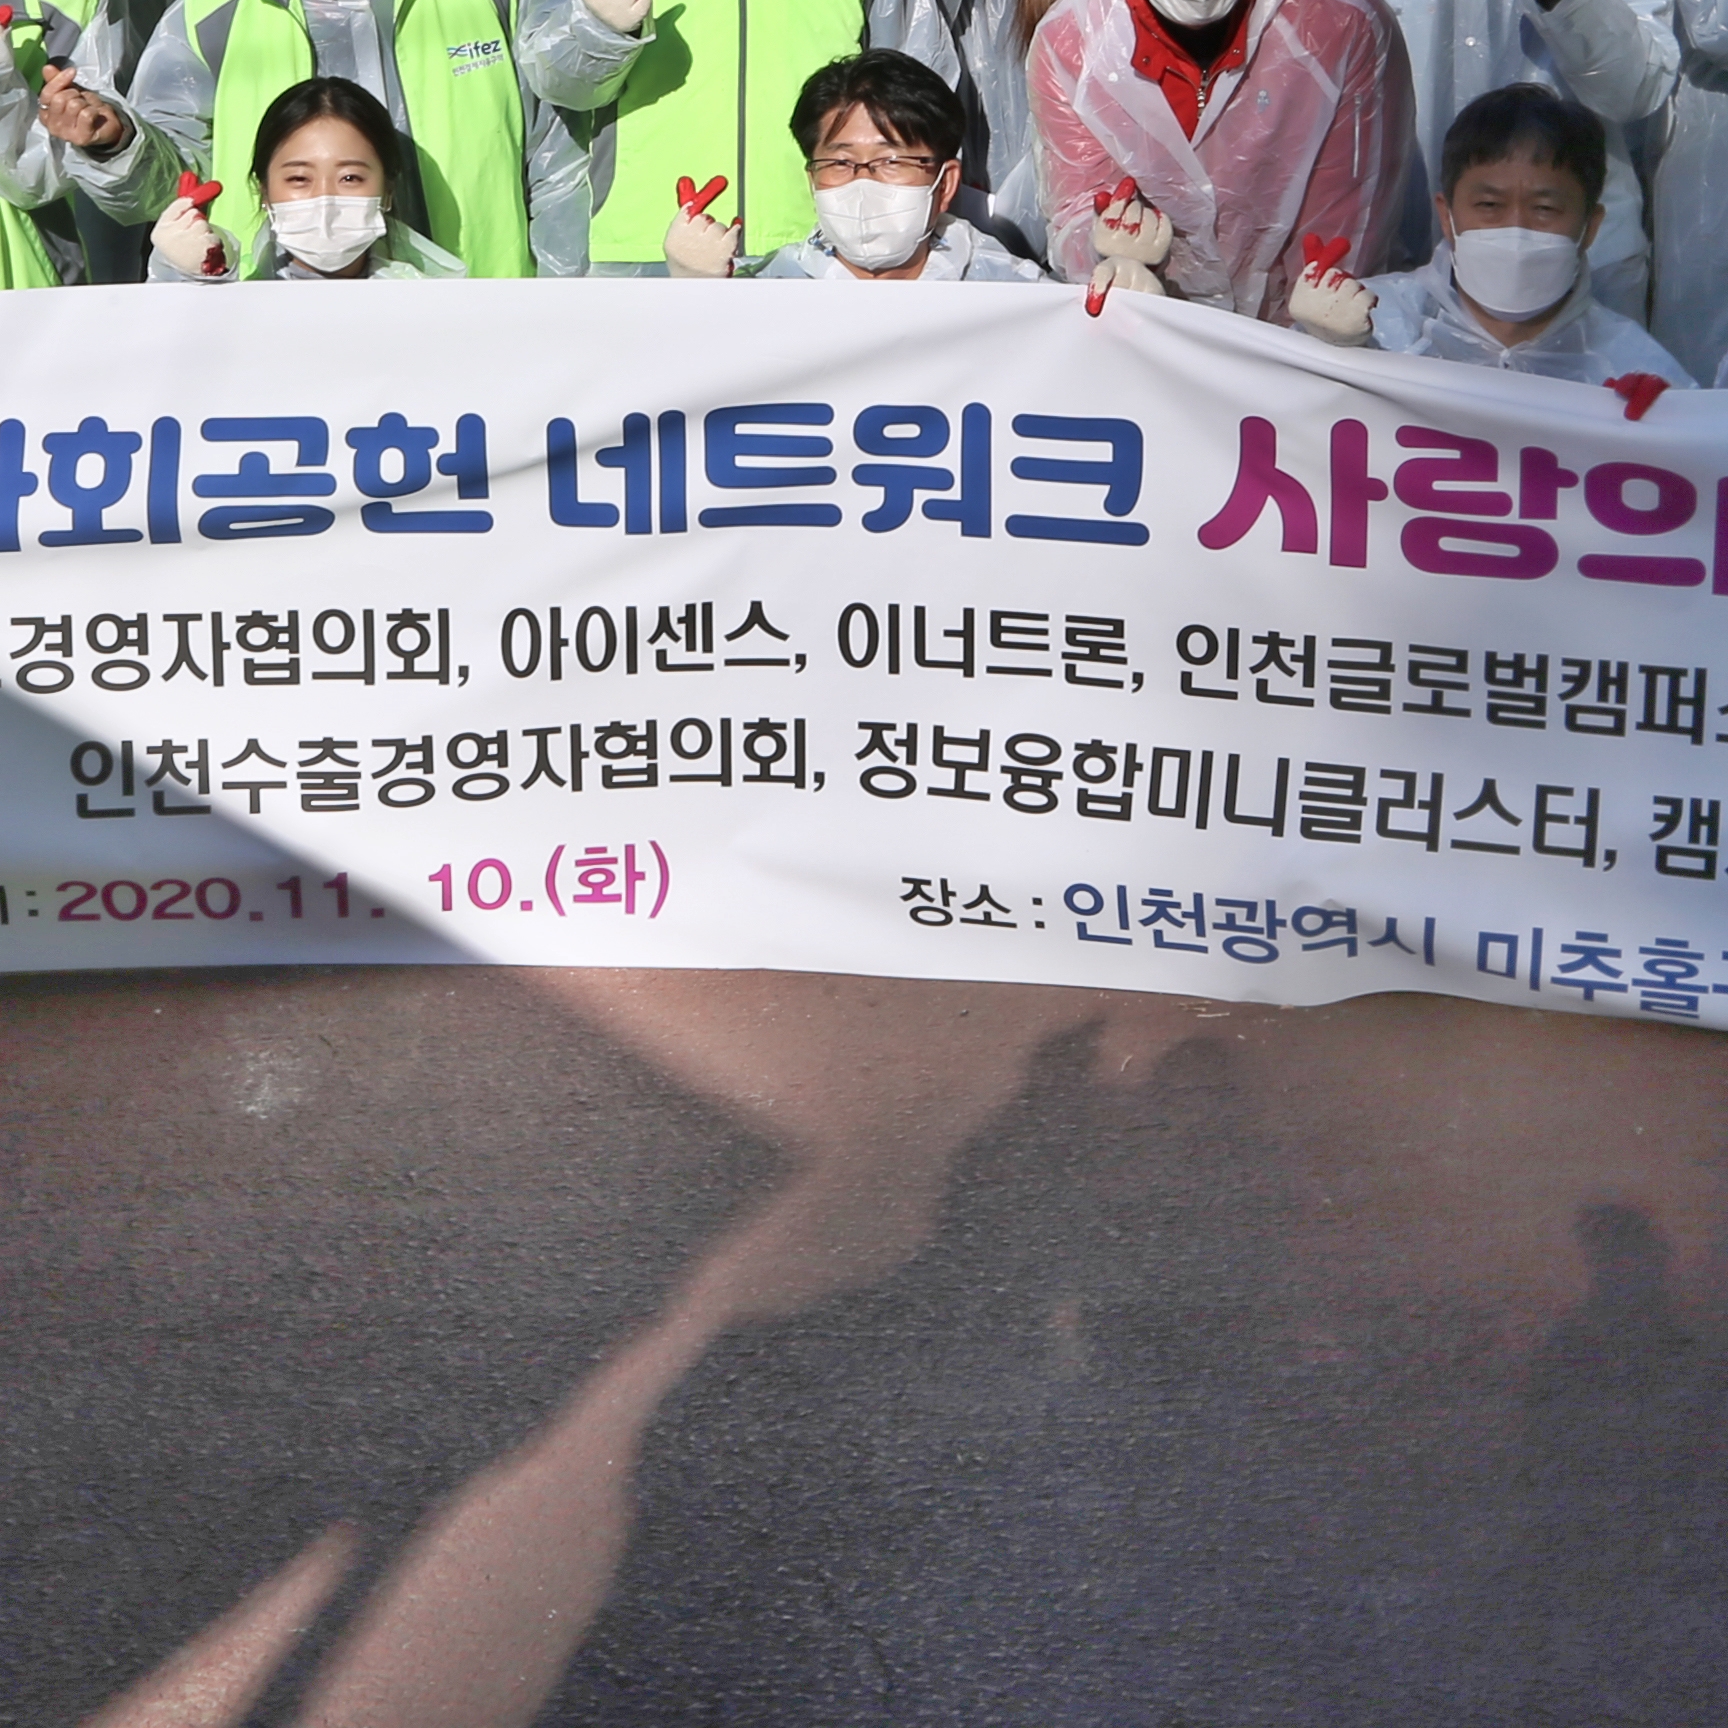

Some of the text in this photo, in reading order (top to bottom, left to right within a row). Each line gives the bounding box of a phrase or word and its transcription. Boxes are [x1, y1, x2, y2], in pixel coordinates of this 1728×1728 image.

[467, 40, 502, 59] ifez
[546, 402, 1150, 547] 네트워크
[500, 599, 808, 682] 아이센스,
[836, 601, 1145, 694] 이너트론,
[70, 716, 826, 820] 인천수출경영자협의회,
[854, 718, 1618, 872] 정보융합미니클러스터,
[1062, 882, 1438, 968] 인천광역시
